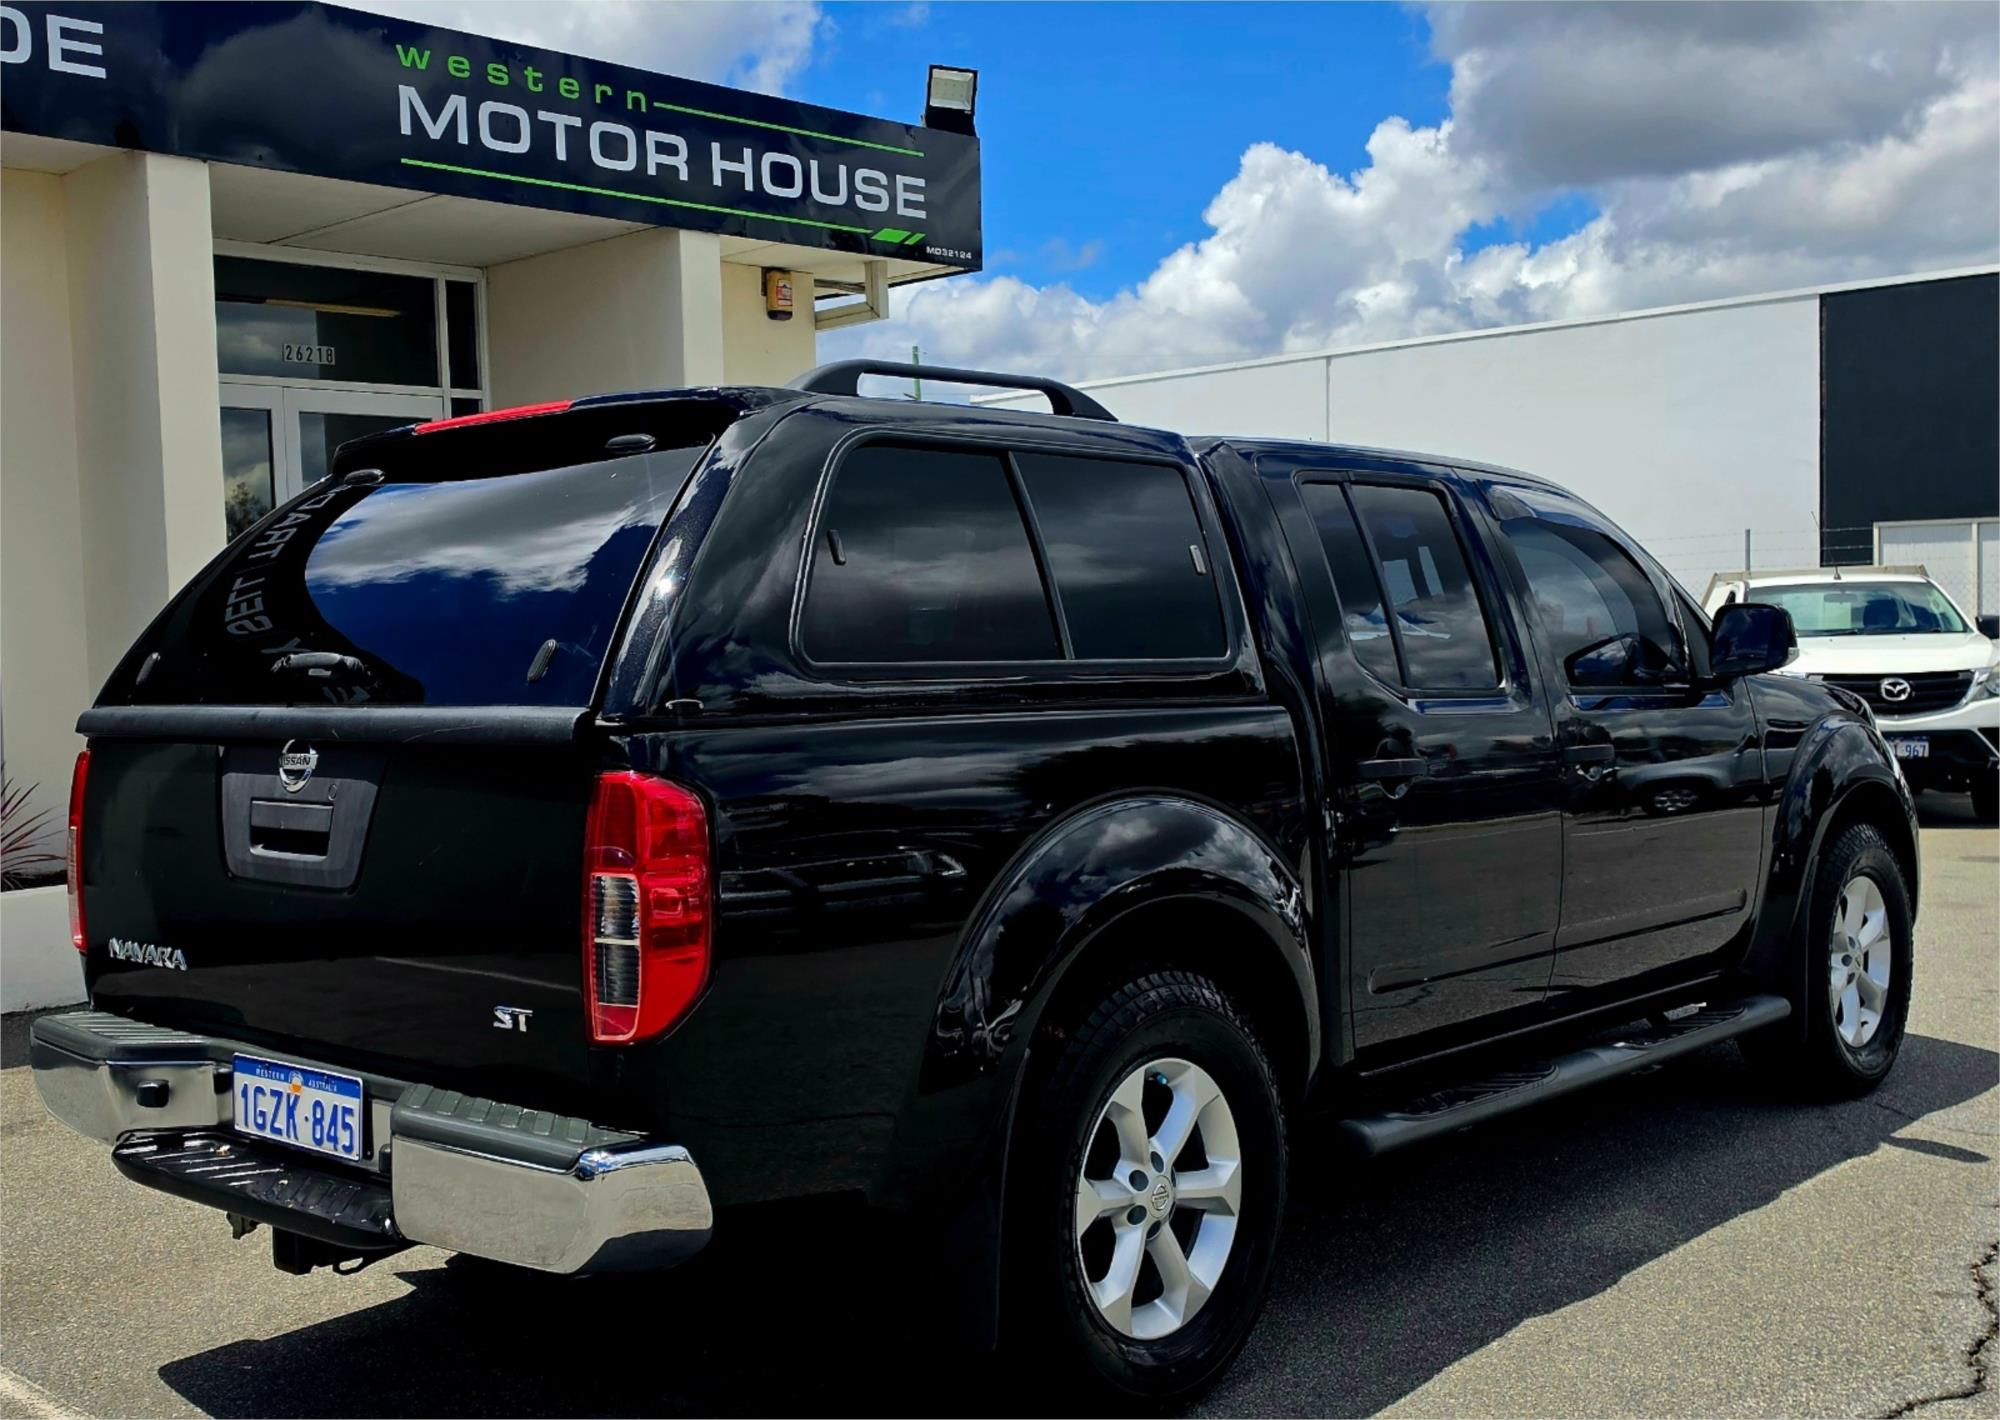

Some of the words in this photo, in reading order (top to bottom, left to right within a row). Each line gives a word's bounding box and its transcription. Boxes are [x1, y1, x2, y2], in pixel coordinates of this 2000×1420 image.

[396, 44, 647, 112] western
[398, 84, 688, 181] MOTOR
[711, 141, 927, 219] HOUSE
[285, 345, 333, 363] 26218
[108, 937, 187, 971] NAVARA
[493, 1005, 533, 1032] ST
[255, 1068, 285, 1081] WESTERN
